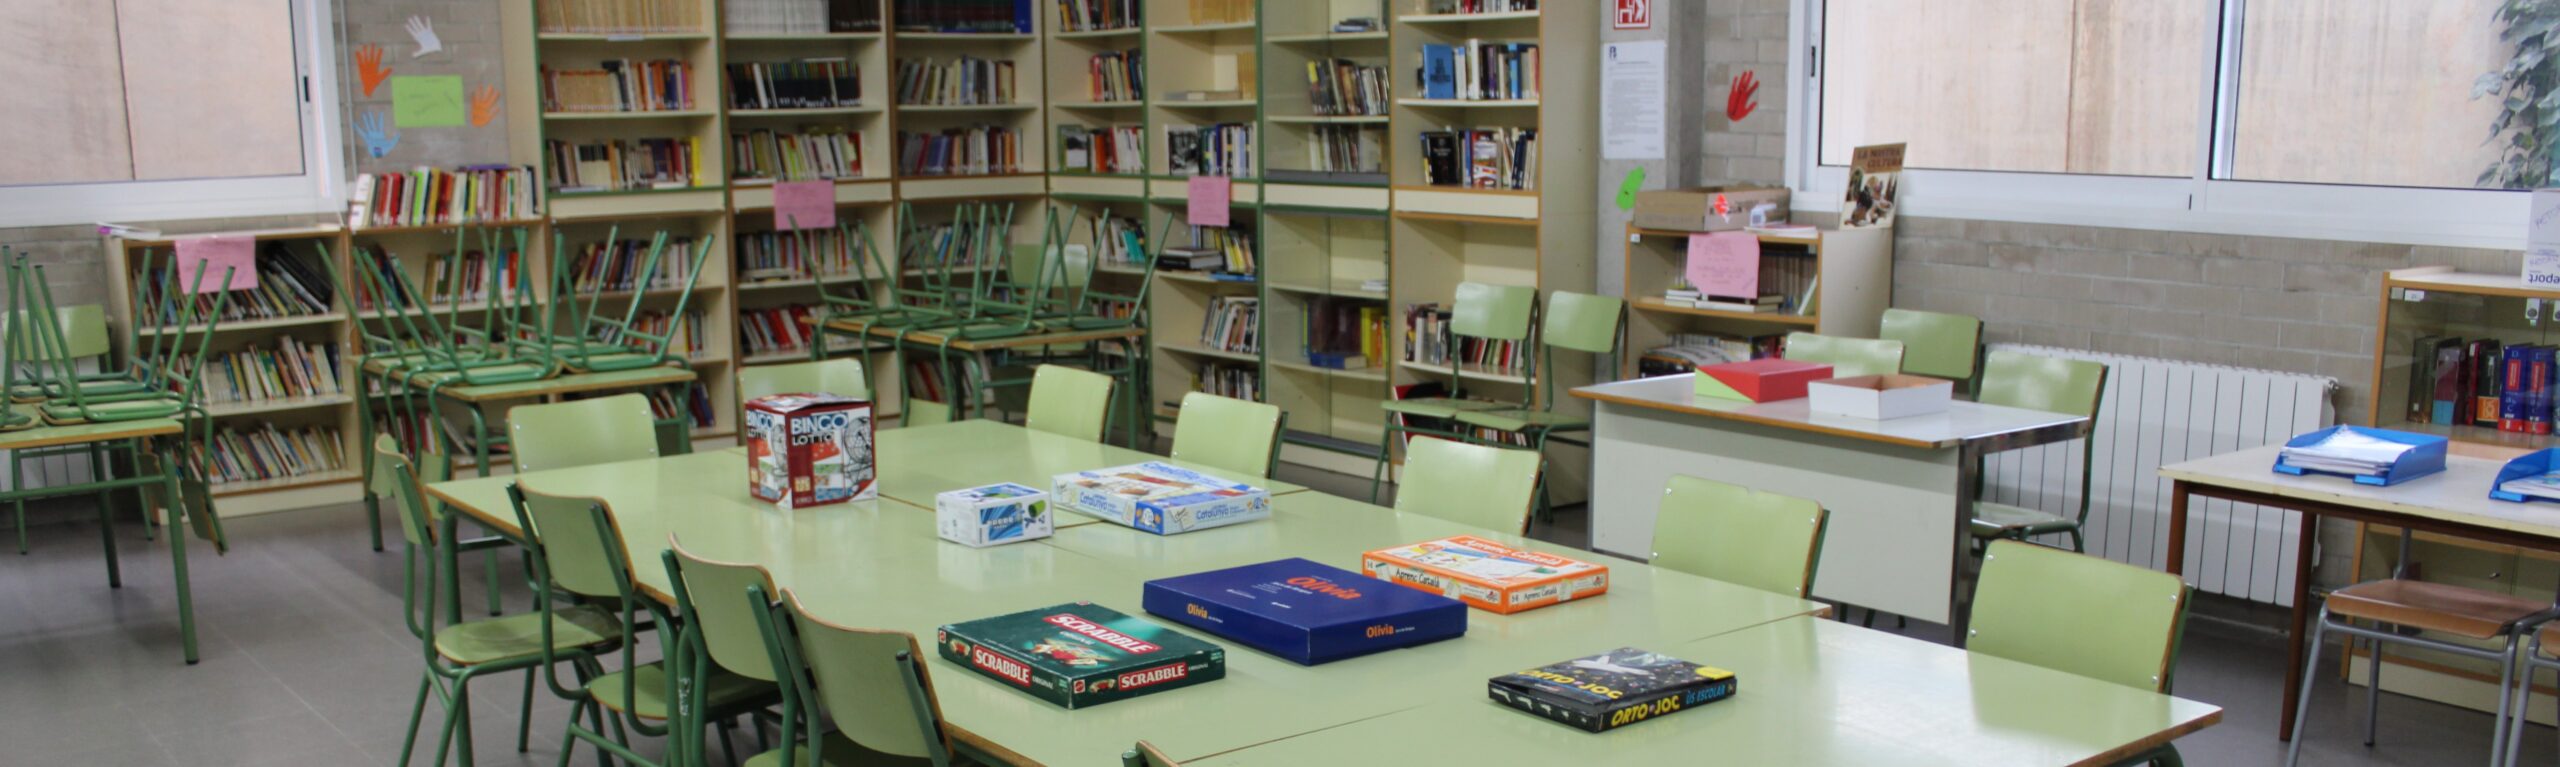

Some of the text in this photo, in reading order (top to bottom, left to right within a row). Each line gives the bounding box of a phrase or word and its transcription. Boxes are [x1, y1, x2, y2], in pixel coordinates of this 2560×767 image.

[747, 409, 774, 430] BINGO
[791, 413, 849, 435] BINGO
[792, 431, 834, 447] LOTTO
[1395, 566, 1418, 583] Aprenc
[1286, 576, 1362, 600] Olivia
[1187, 602, 1208, 619] Olivia
[1050, 615, 1154, 653] SCRABBLE
[1366, 624, 1394, 639] Olivia
[975, 649, 1031, 684] SCRABBLE
[1121, 664, 1186, 689] SCRABBLE
[1654, 695, 1680, 715] JOC
